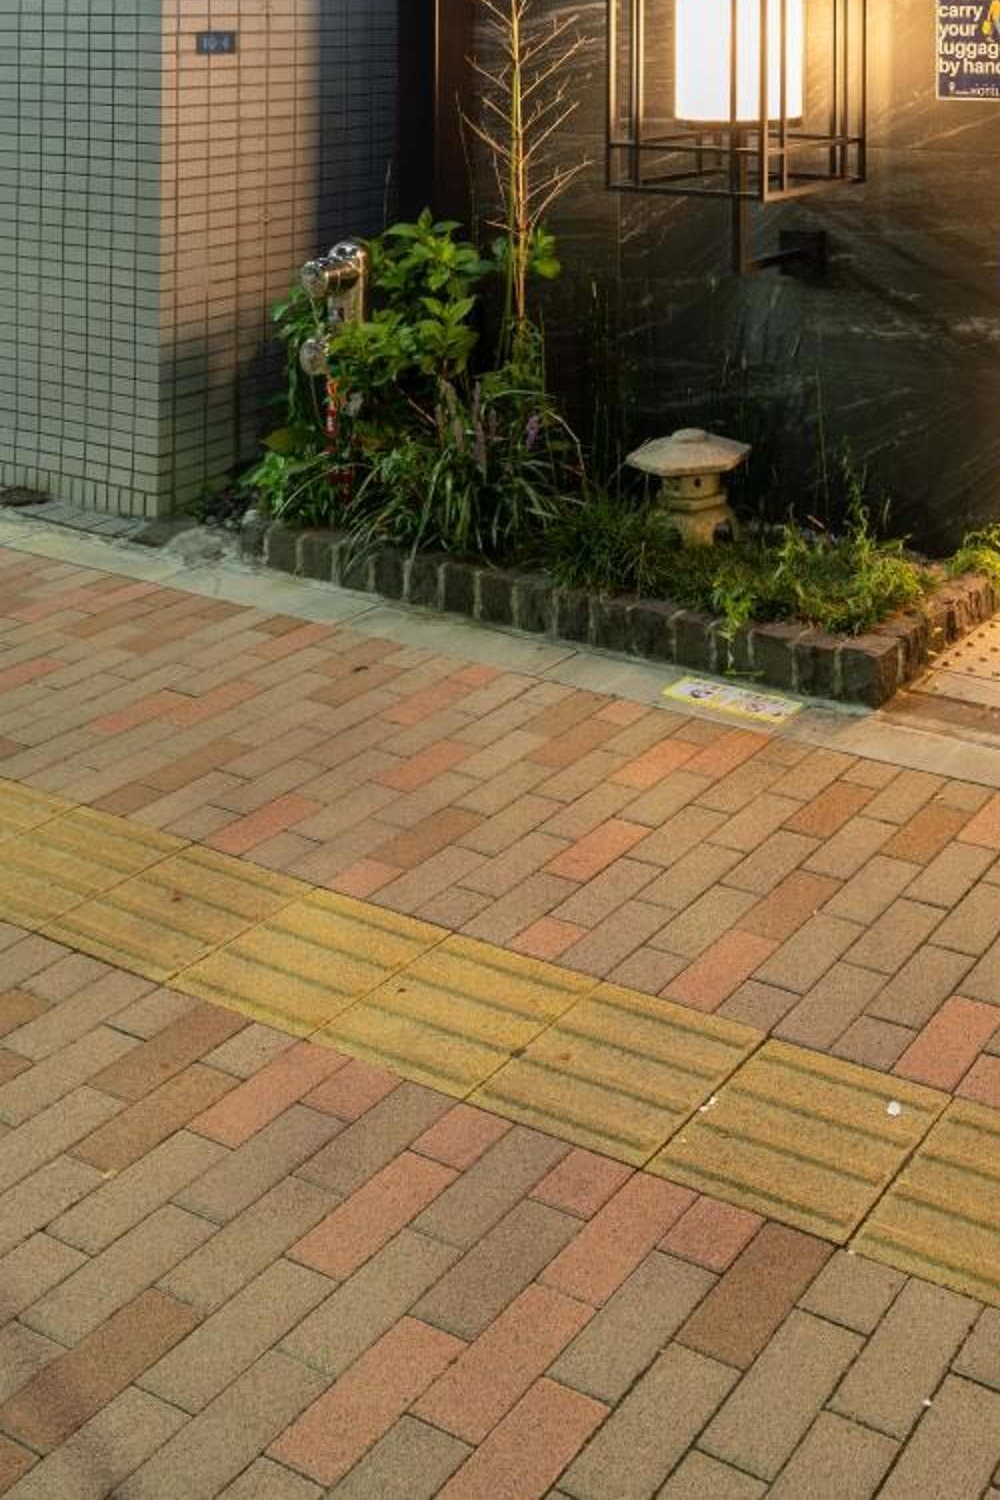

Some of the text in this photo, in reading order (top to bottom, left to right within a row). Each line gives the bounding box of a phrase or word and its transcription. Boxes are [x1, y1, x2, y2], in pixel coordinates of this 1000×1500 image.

[938, 4, 983, 22] carry
[938, 22, 978, 40] your
[939, 58, 960, 77] by
